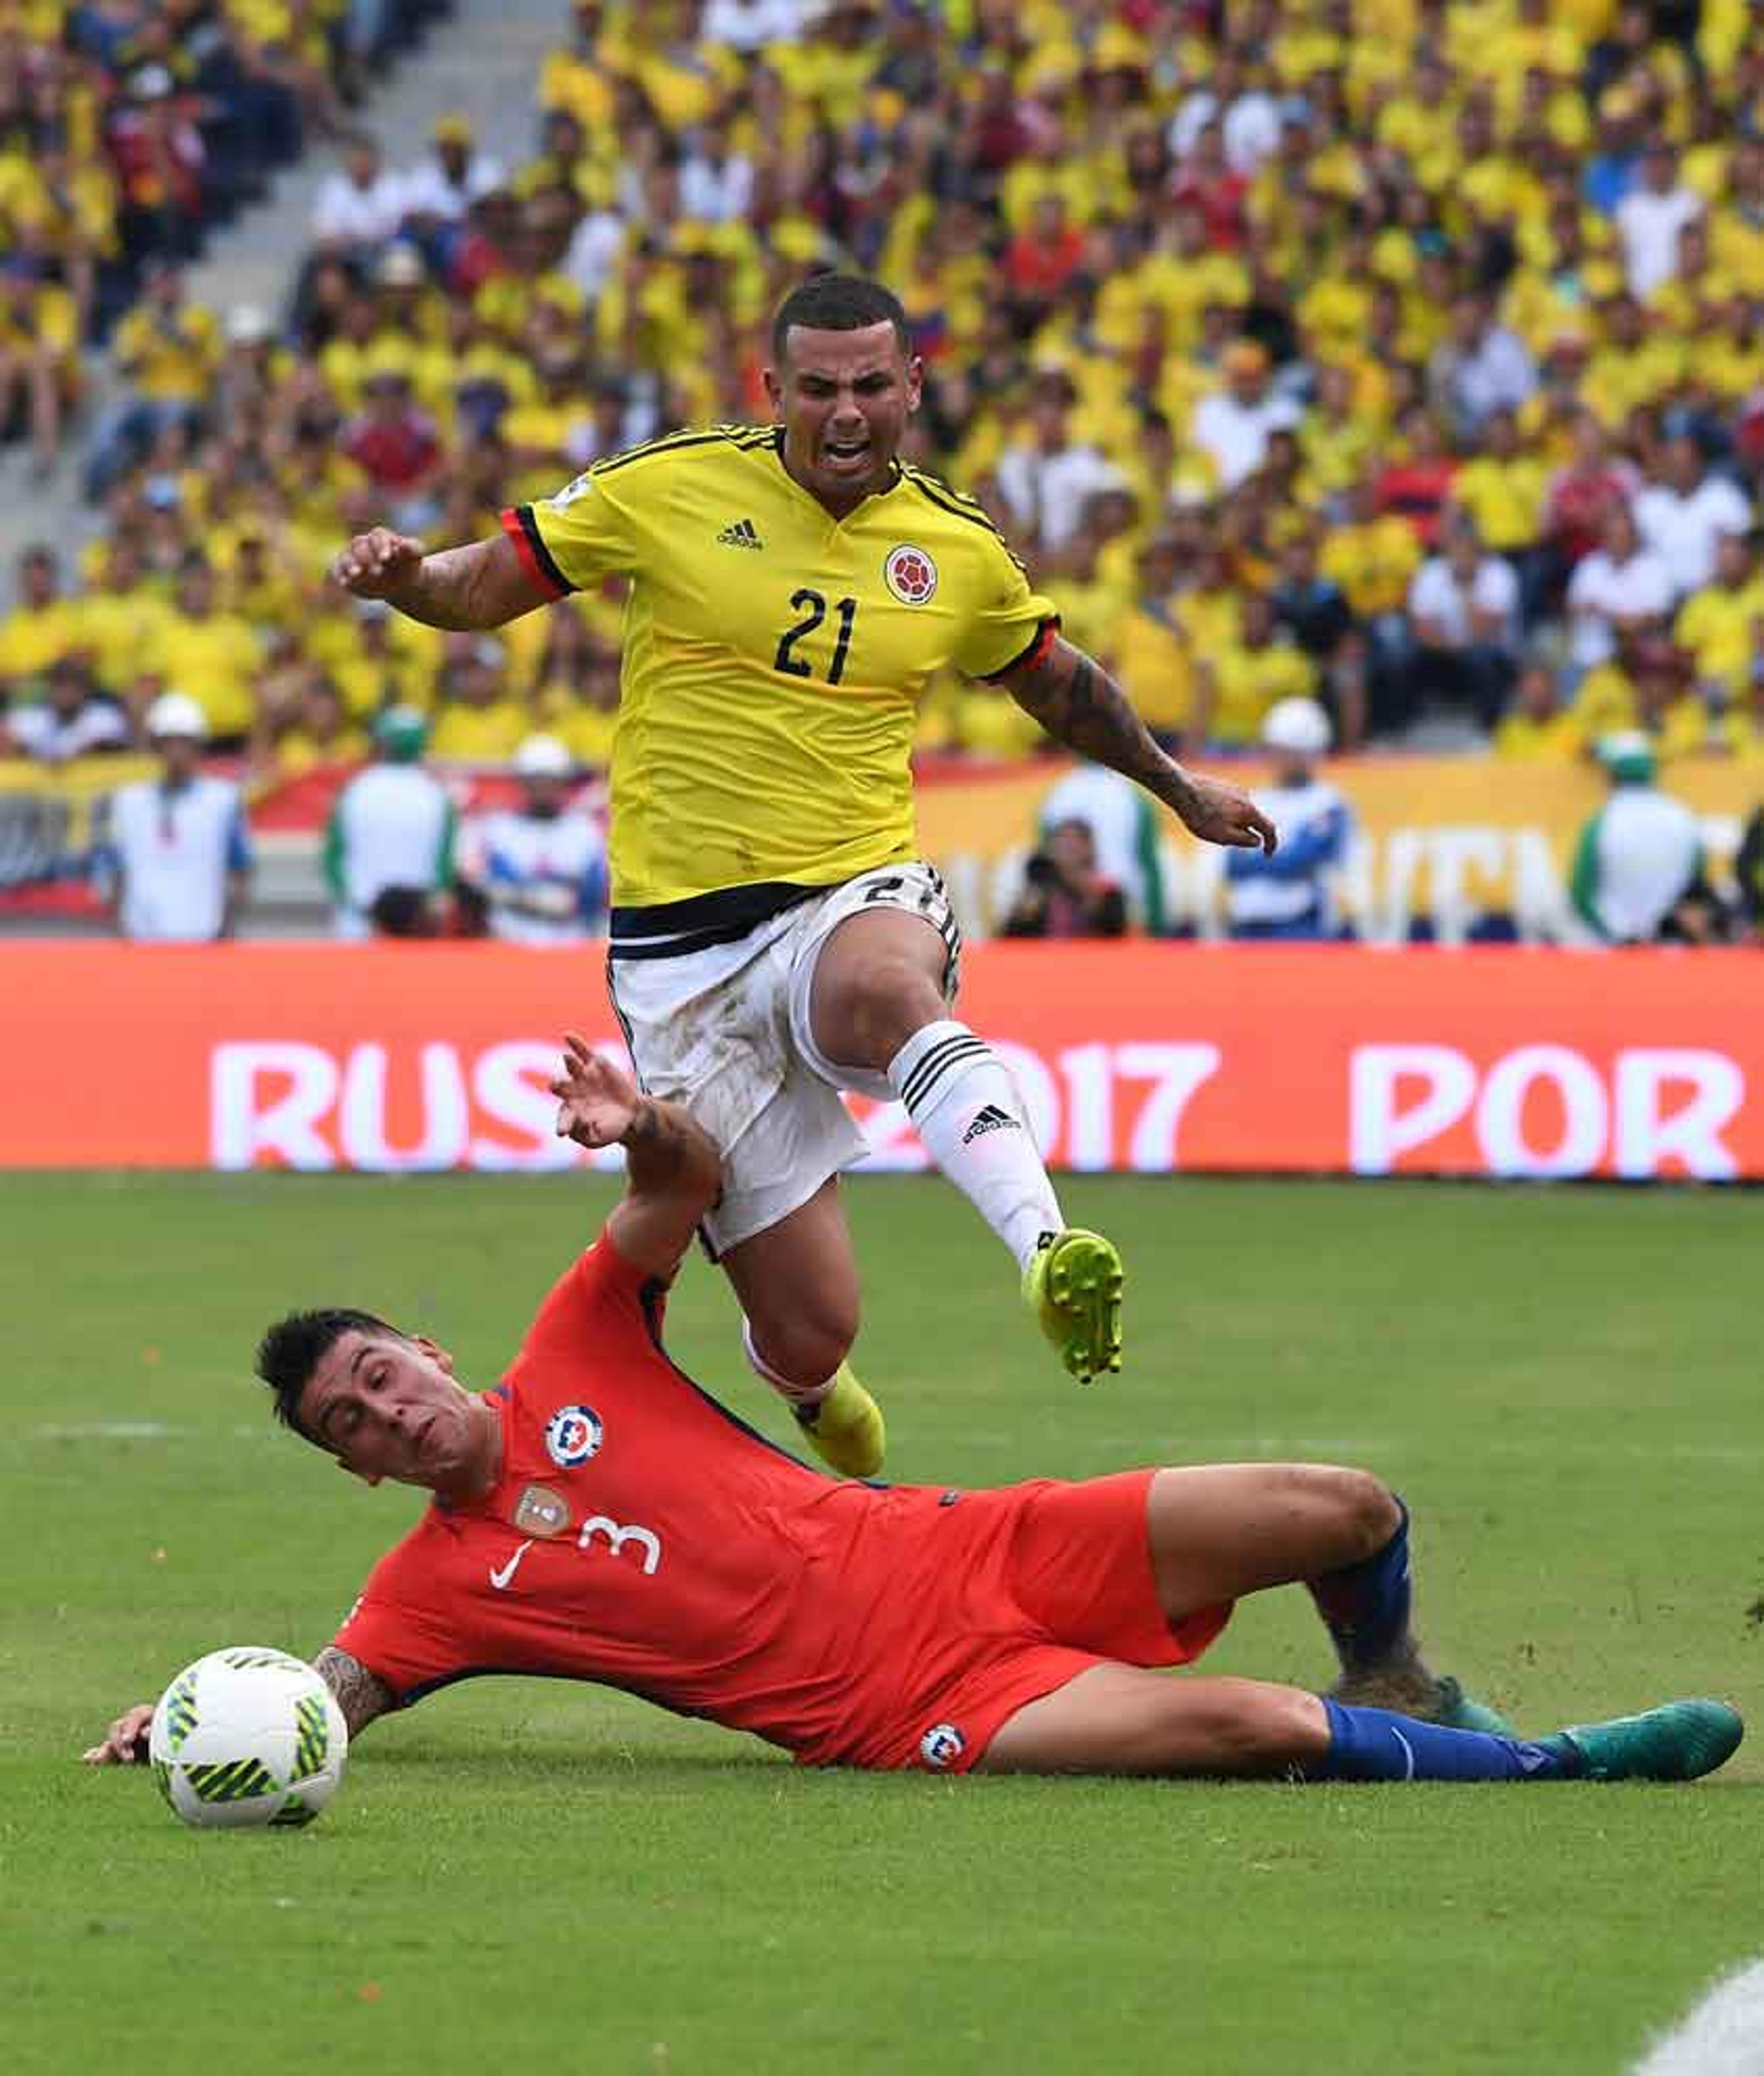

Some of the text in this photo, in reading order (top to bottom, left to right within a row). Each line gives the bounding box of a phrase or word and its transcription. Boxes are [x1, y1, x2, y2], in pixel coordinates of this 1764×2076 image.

[774, 589, 856, 685] 21
[1349, 1042, 1746, 1178] POR
[578, 1516, 660, 1575] 3
